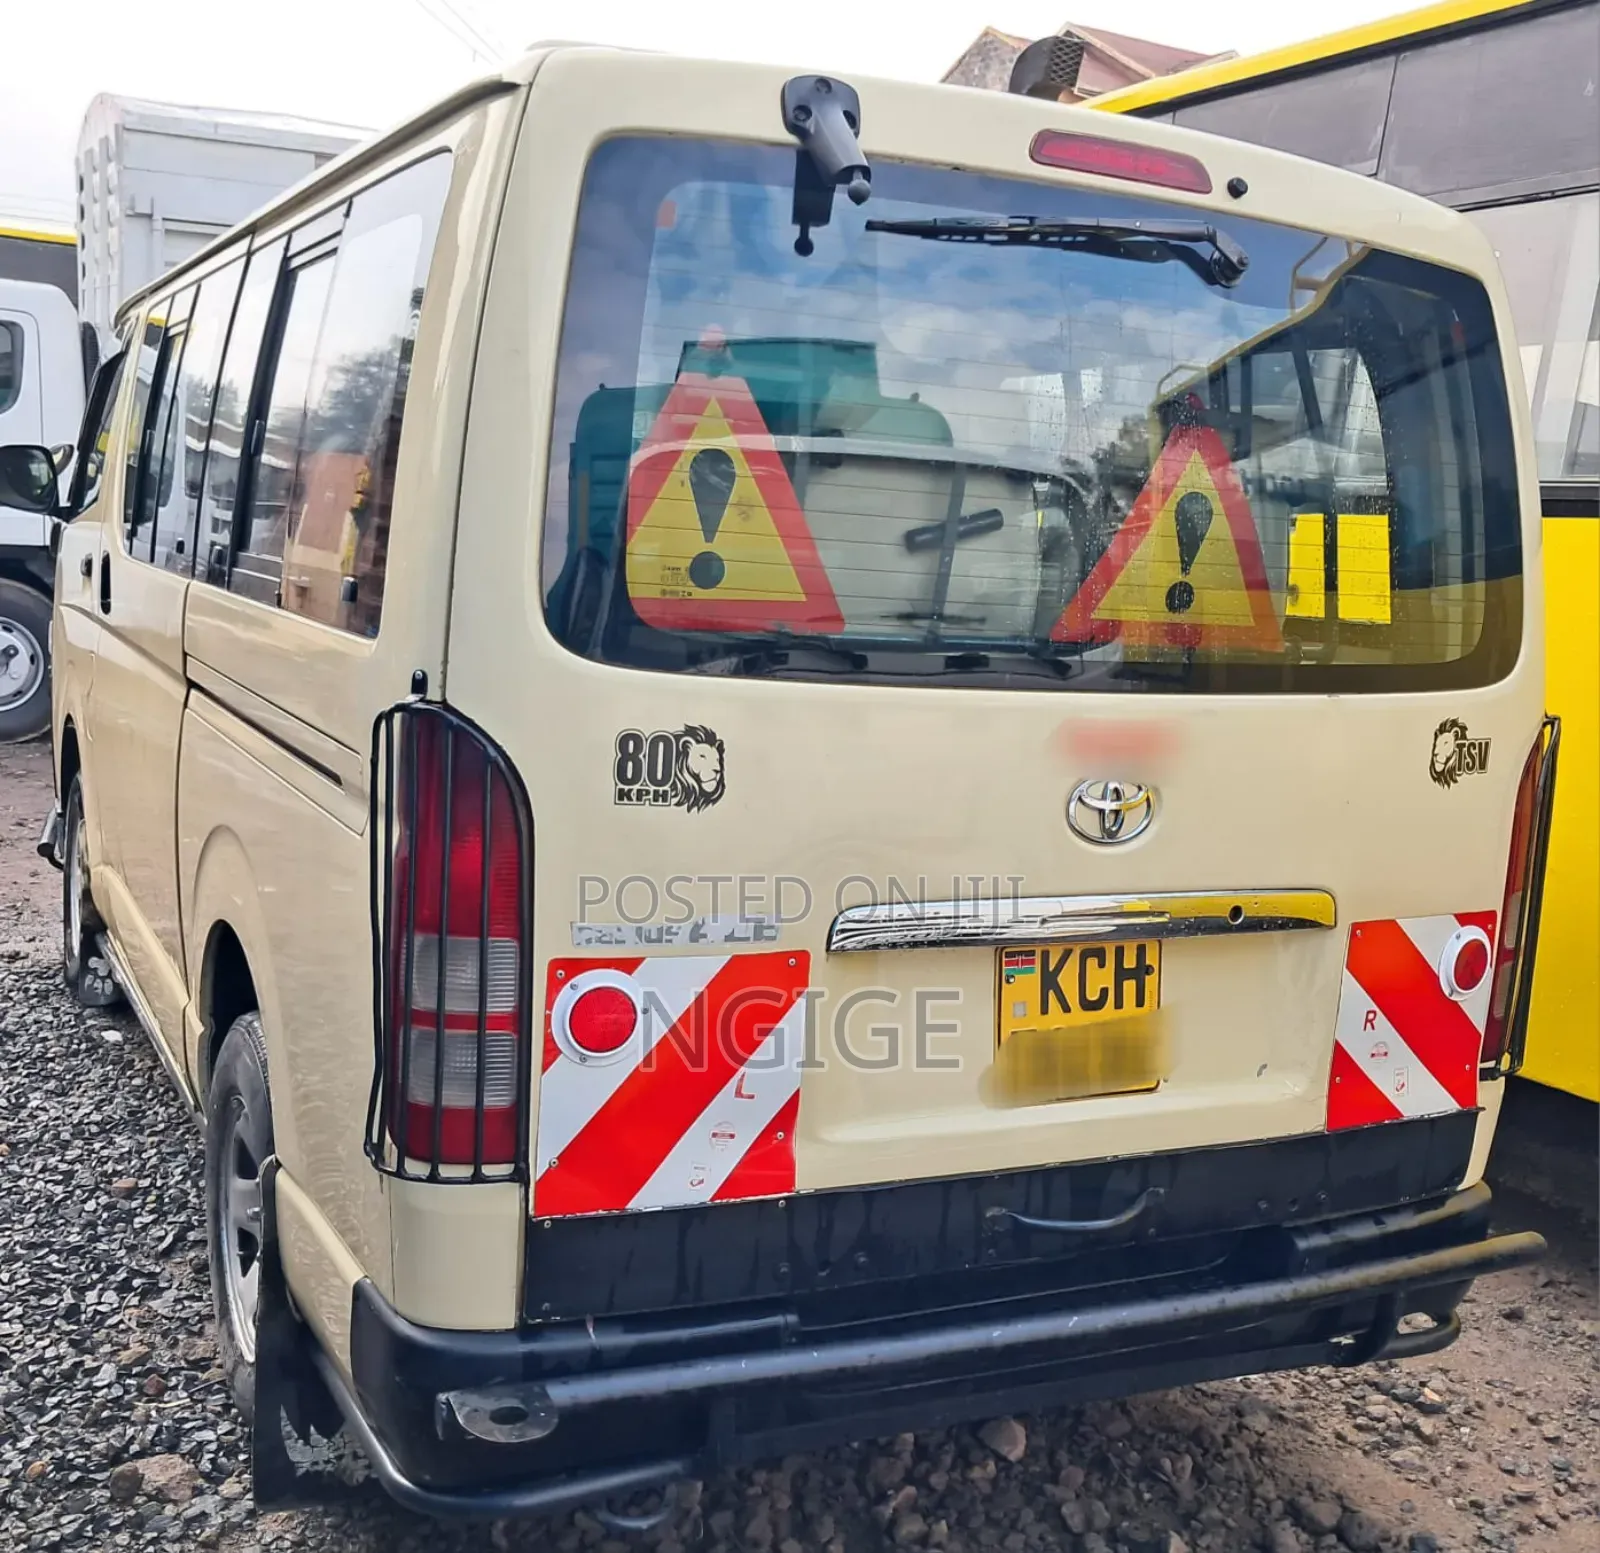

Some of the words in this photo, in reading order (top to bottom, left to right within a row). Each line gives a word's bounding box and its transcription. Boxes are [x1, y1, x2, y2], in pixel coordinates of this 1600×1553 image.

[614, 730, 676, 788] 80
[1456, 740, 1490, 773] TSV
[616, 787, 670, 803] KPH
[1040, 944, 1147, 1016] KCH
[1363, 1009, 1377, 1032] R
[734, 1071, 756, 1099] L
